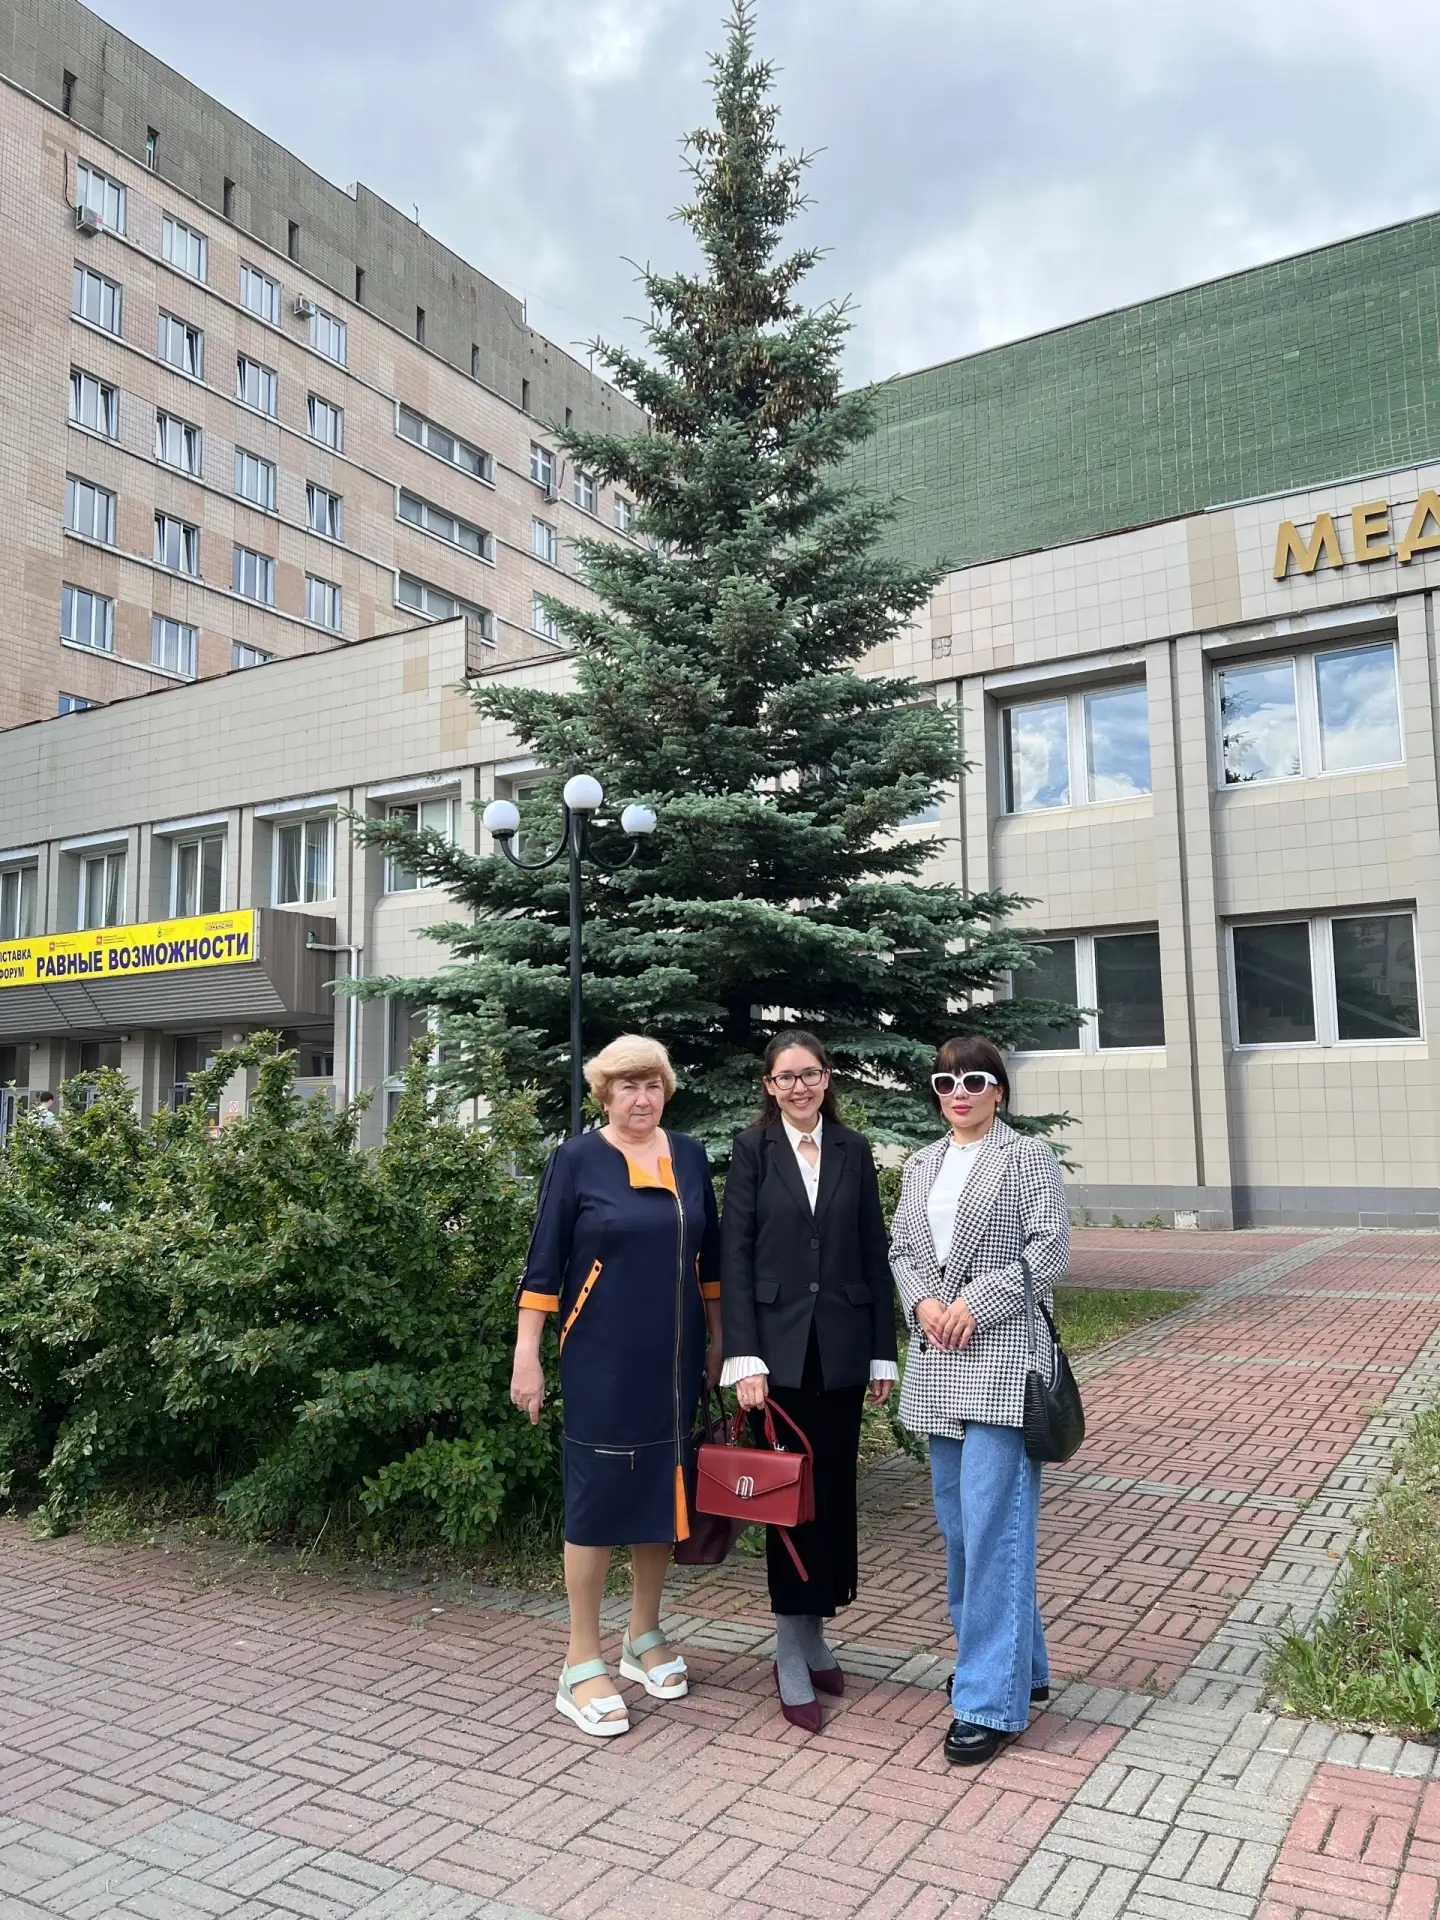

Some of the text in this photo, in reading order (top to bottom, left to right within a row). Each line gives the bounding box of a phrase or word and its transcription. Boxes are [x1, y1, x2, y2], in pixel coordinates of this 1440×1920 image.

[1273, 489, 1440, 580] МЕД
[0, 948, 31, 962] СТАВКА
[36, 932, 249, 977] РАВНЫЕ ВОЗМОЖНОСТИ
